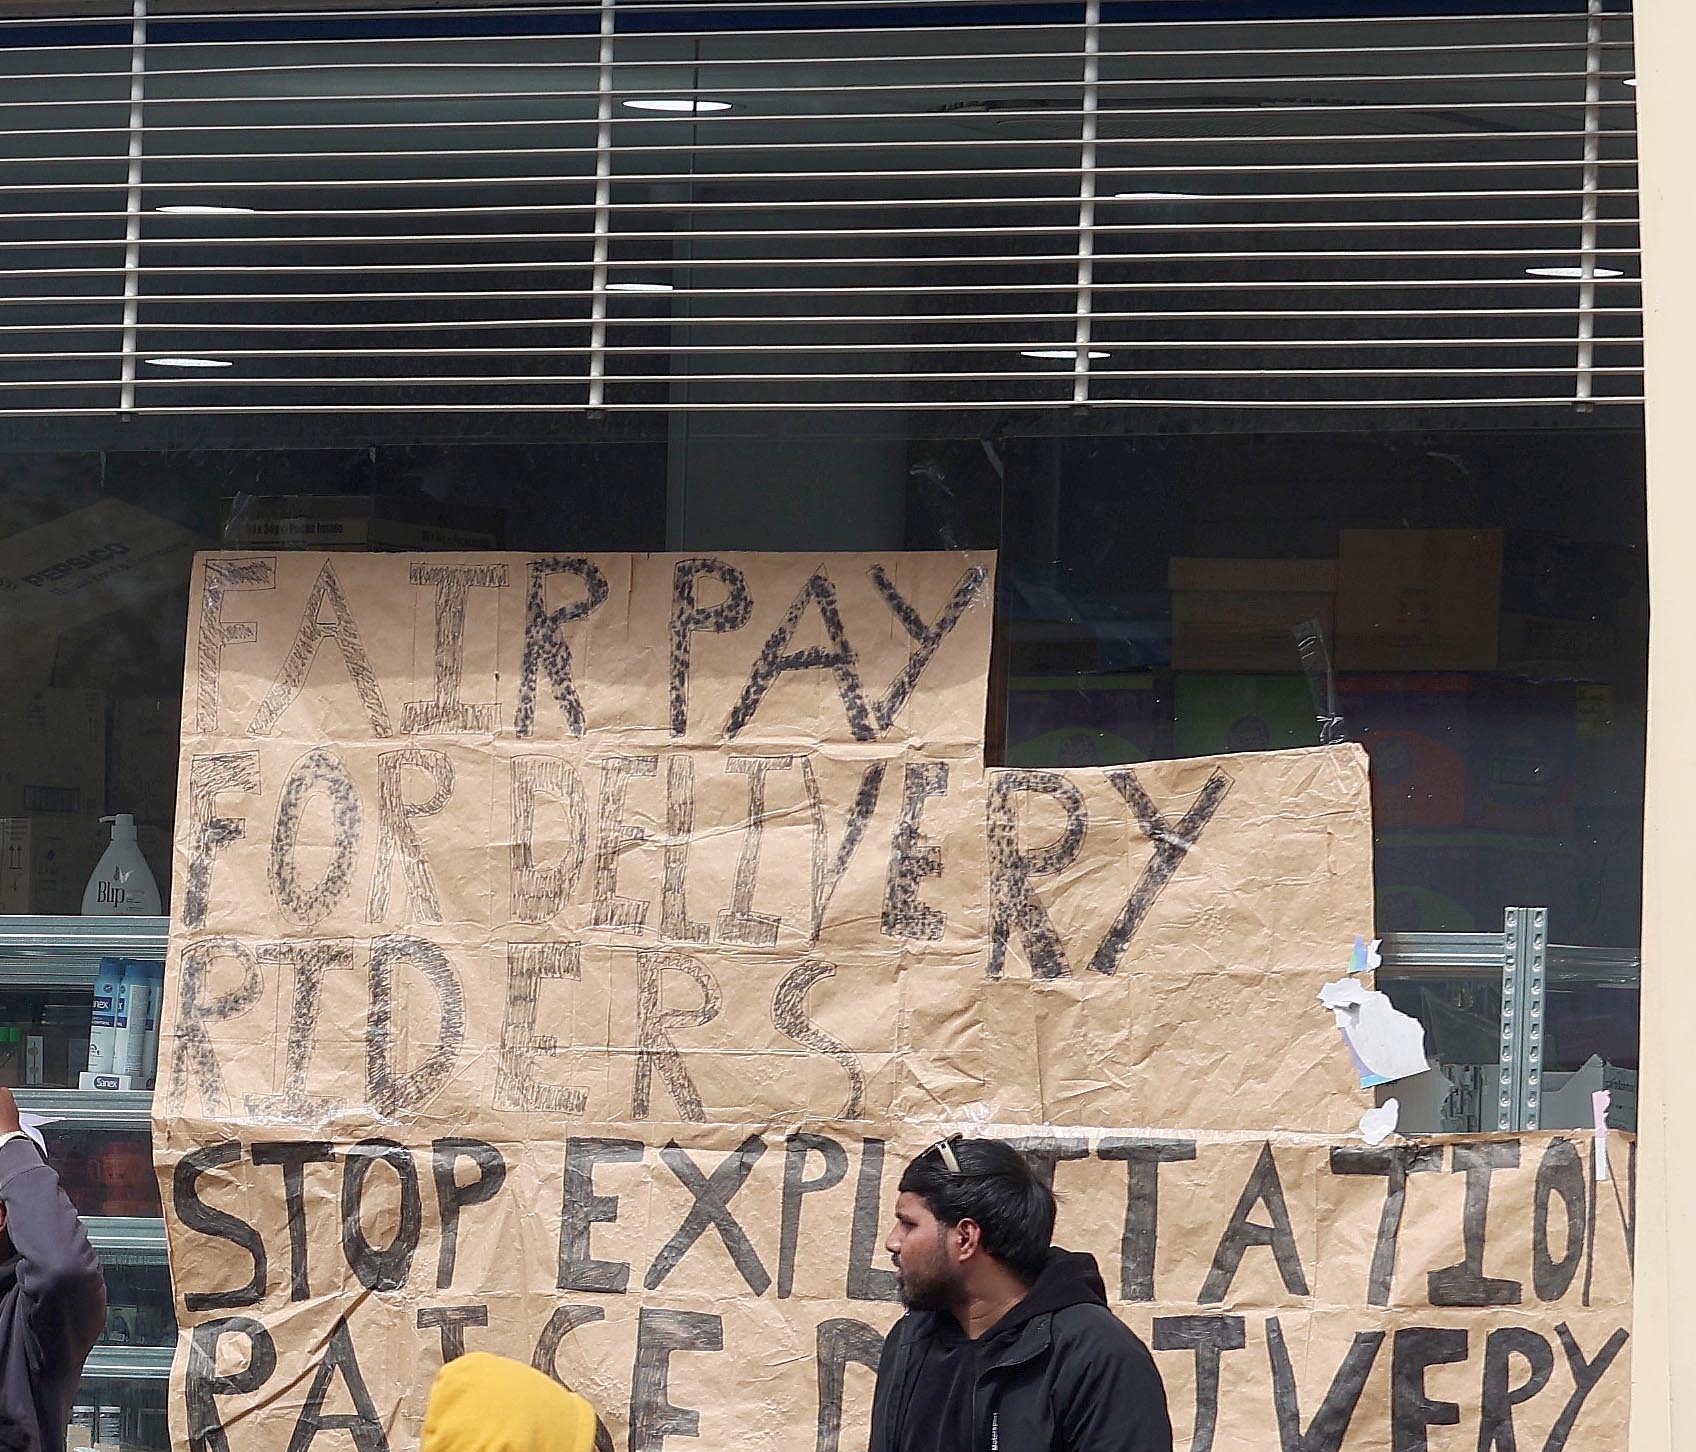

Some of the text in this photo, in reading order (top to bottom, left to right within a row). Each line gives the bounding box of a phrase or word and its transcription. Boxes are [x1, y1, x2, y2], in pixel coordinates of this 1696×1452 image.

[20, 542, 132, 588] PEPSICO
[196, 556, 988, 743] FAIR PAY
[183, 748, 1237, 981] FOR DELIVERY
[96, 1076, 118, 1089] Sanex
[173, 1133, 1636, 1312] STOP EXPLTATION
